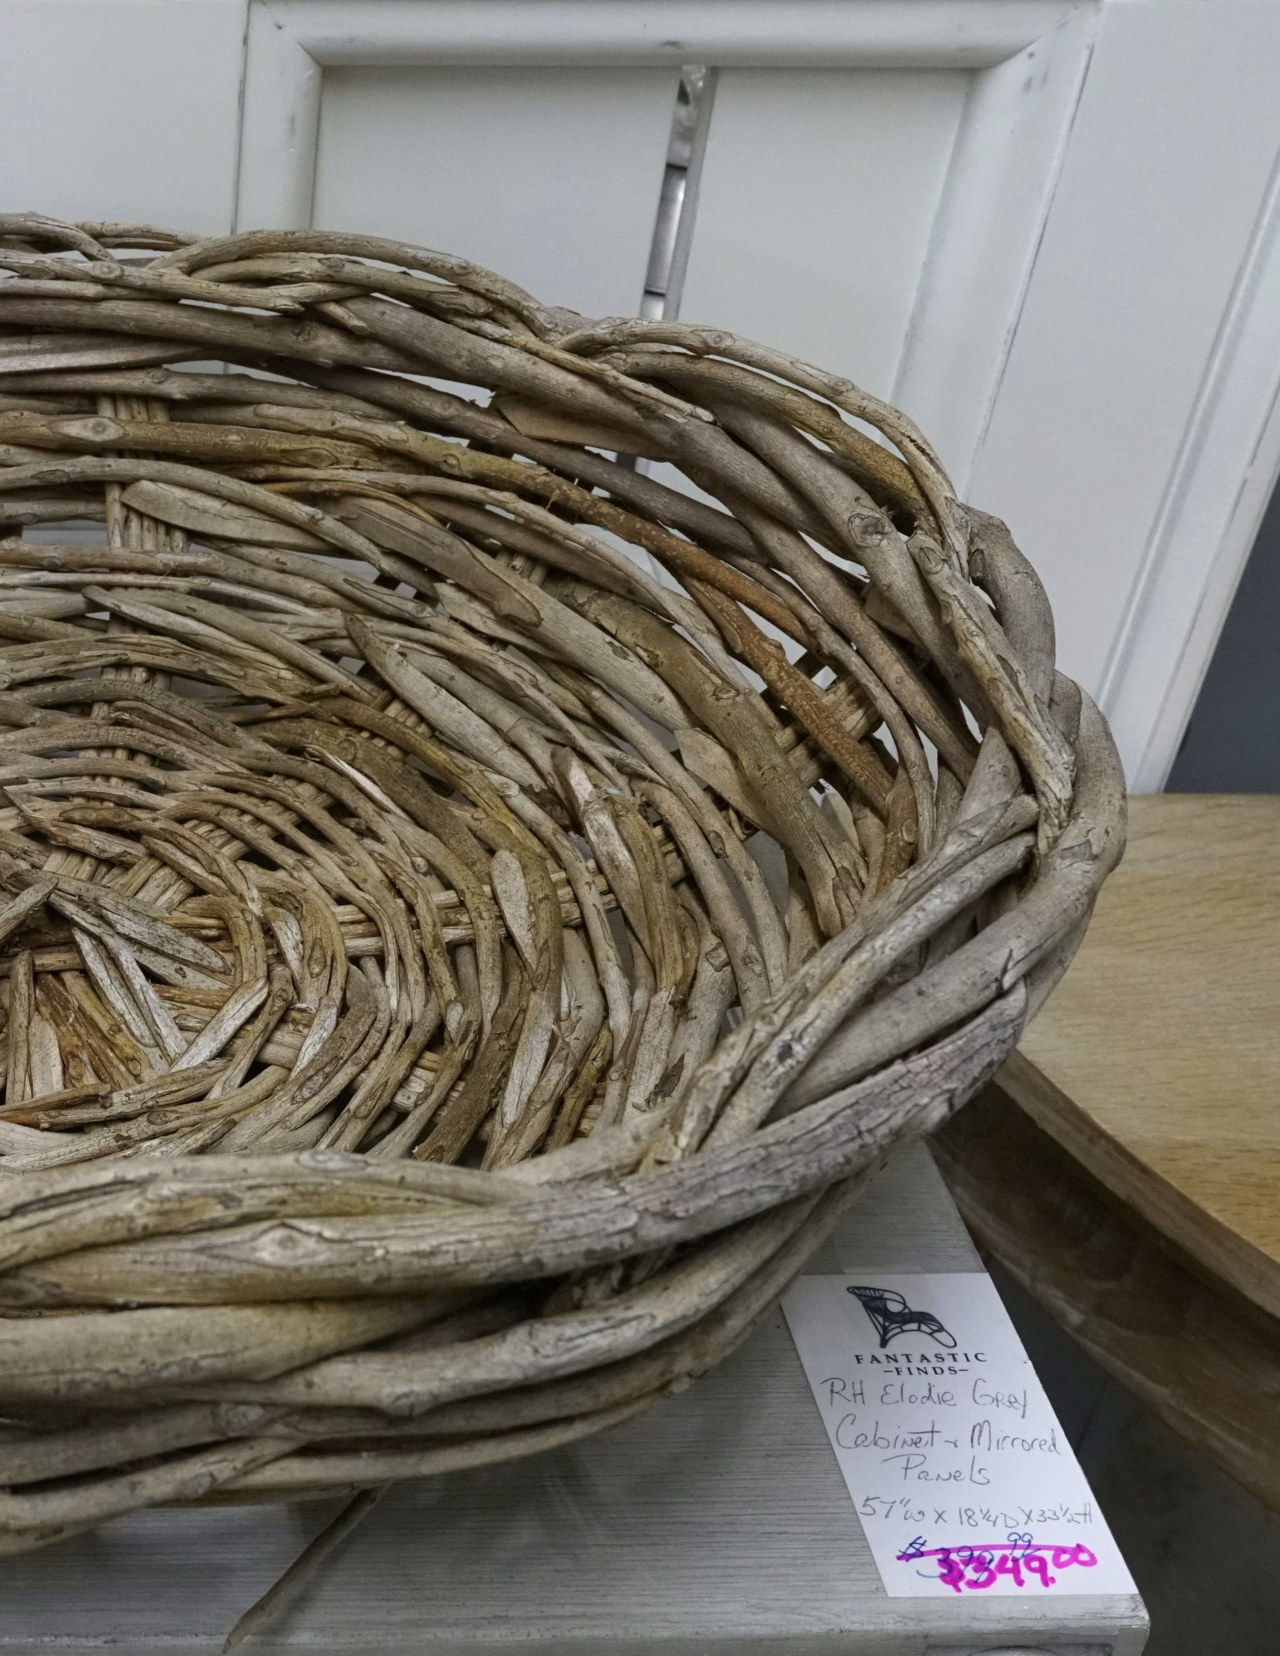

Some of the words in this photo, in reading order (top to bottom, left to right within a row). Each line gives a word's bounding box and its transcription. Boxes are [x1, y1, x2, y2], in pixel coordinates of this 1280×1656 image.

[854, 1352, 988, 1364] FANTASTIC
[820, 1377, 866, 1406] RH
[880, 1382, 957, 1407] Elodie
[835, 1413, 942, 1450] Cabinet
[970, 1419, 1063, 1456] Mirrored
[882, 1453, 991, 1486] Panels
